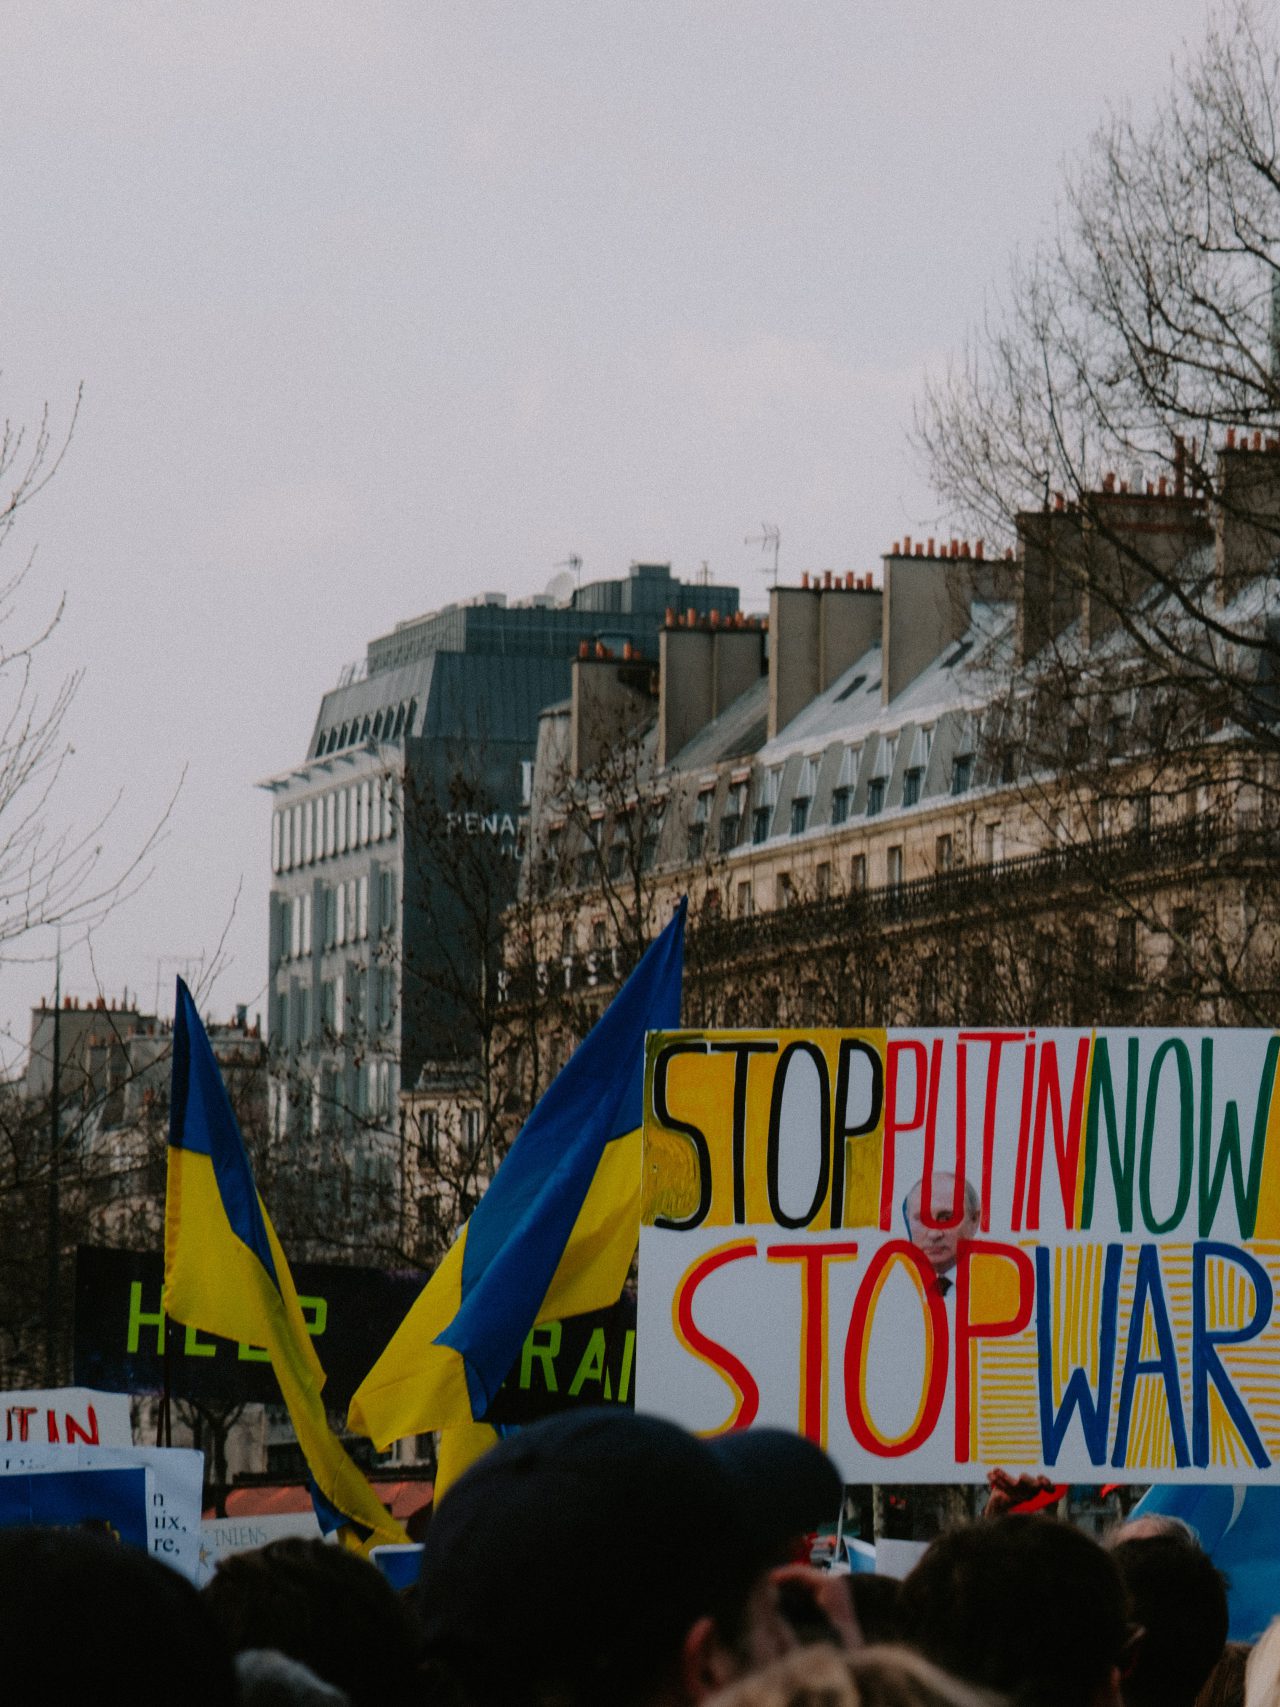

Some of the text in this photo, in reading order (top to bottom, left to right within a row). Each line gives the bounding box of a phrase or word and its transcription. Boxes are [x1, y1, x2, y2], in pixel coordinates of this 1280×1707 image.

[652, 1038, 884, 1230] STOP
[502, 1319, 636, 1403] RAI
[672, 1237, 1274, 1470] STOP WAR
[6, 1401, 100, 1446] TIN
